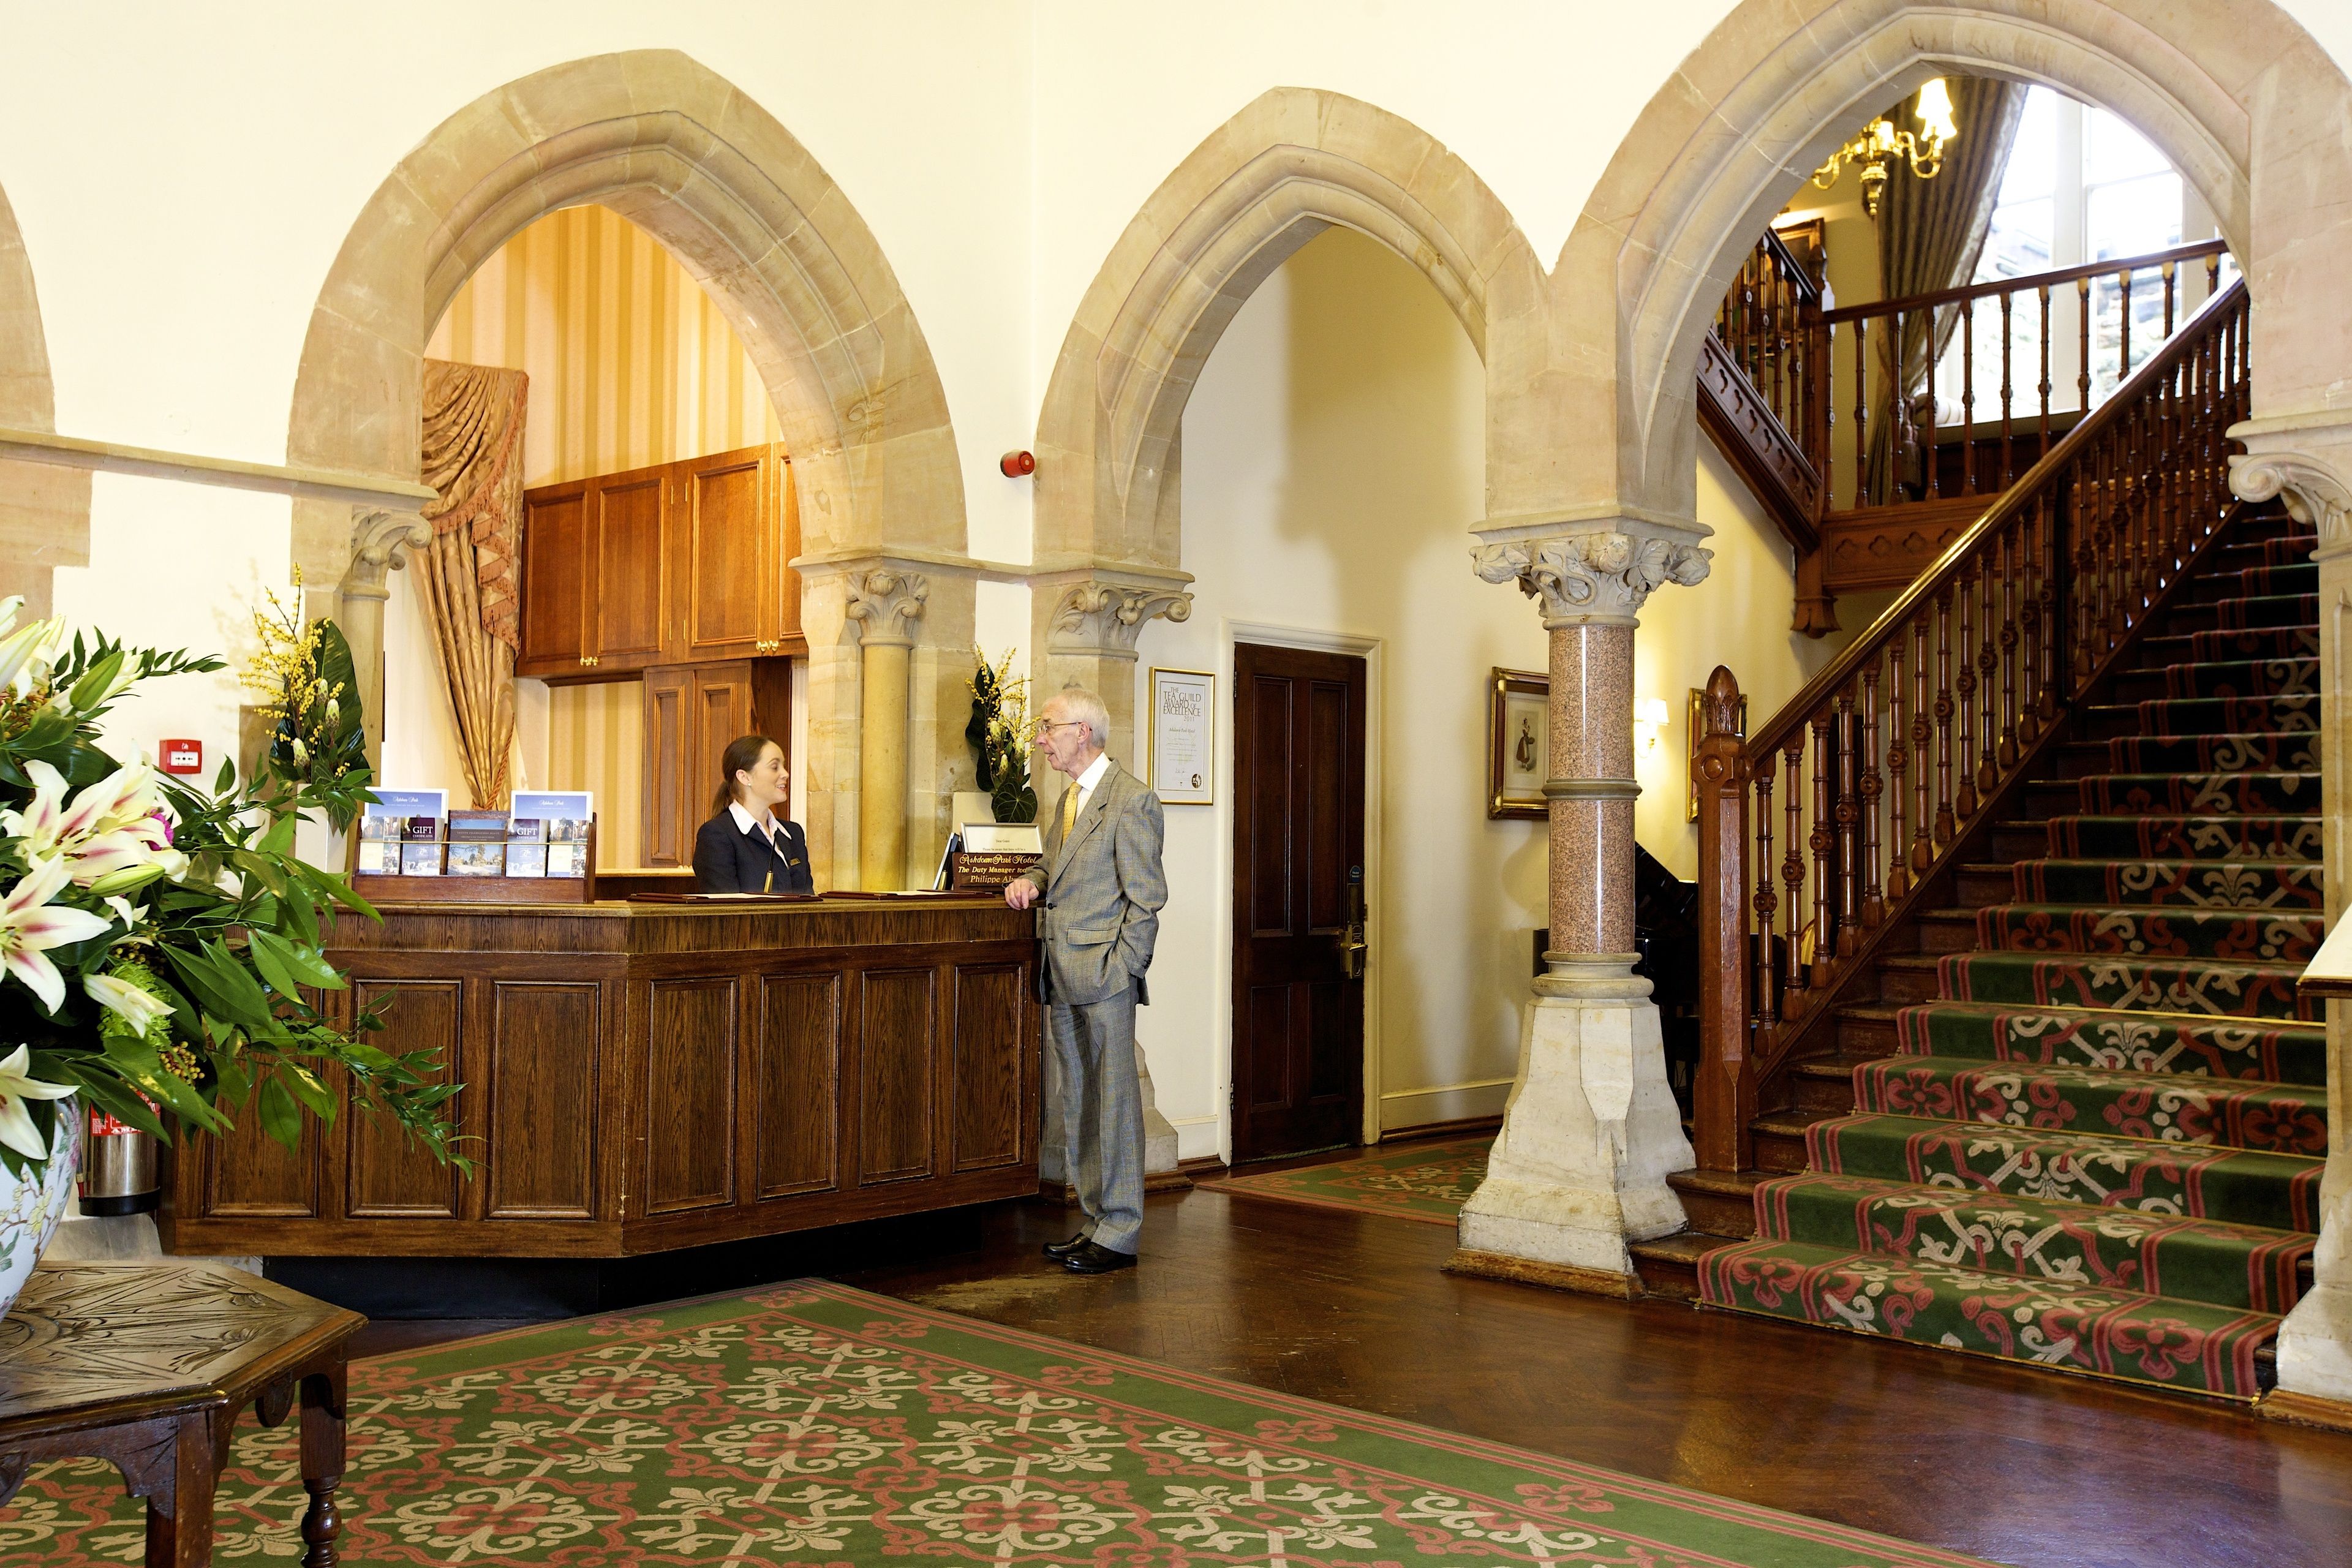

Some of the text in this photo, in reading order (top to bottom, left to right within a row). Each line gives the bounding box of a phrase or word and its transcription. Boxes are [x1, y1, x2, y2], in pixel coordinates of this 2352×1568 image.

[1163, 691, 1202, 703] TEA GUILD
[1163, 699, 1189, 709] AWARD
[1163, 706, 1201, 717] EXCELLENCE
[412, 826, 434, 834] GIFT
[959, 853, 1037, 865] Ashdown Park Hotel
[971, 866, 987, 875] Duty
[970, 875, 1001, 884] Philippe
